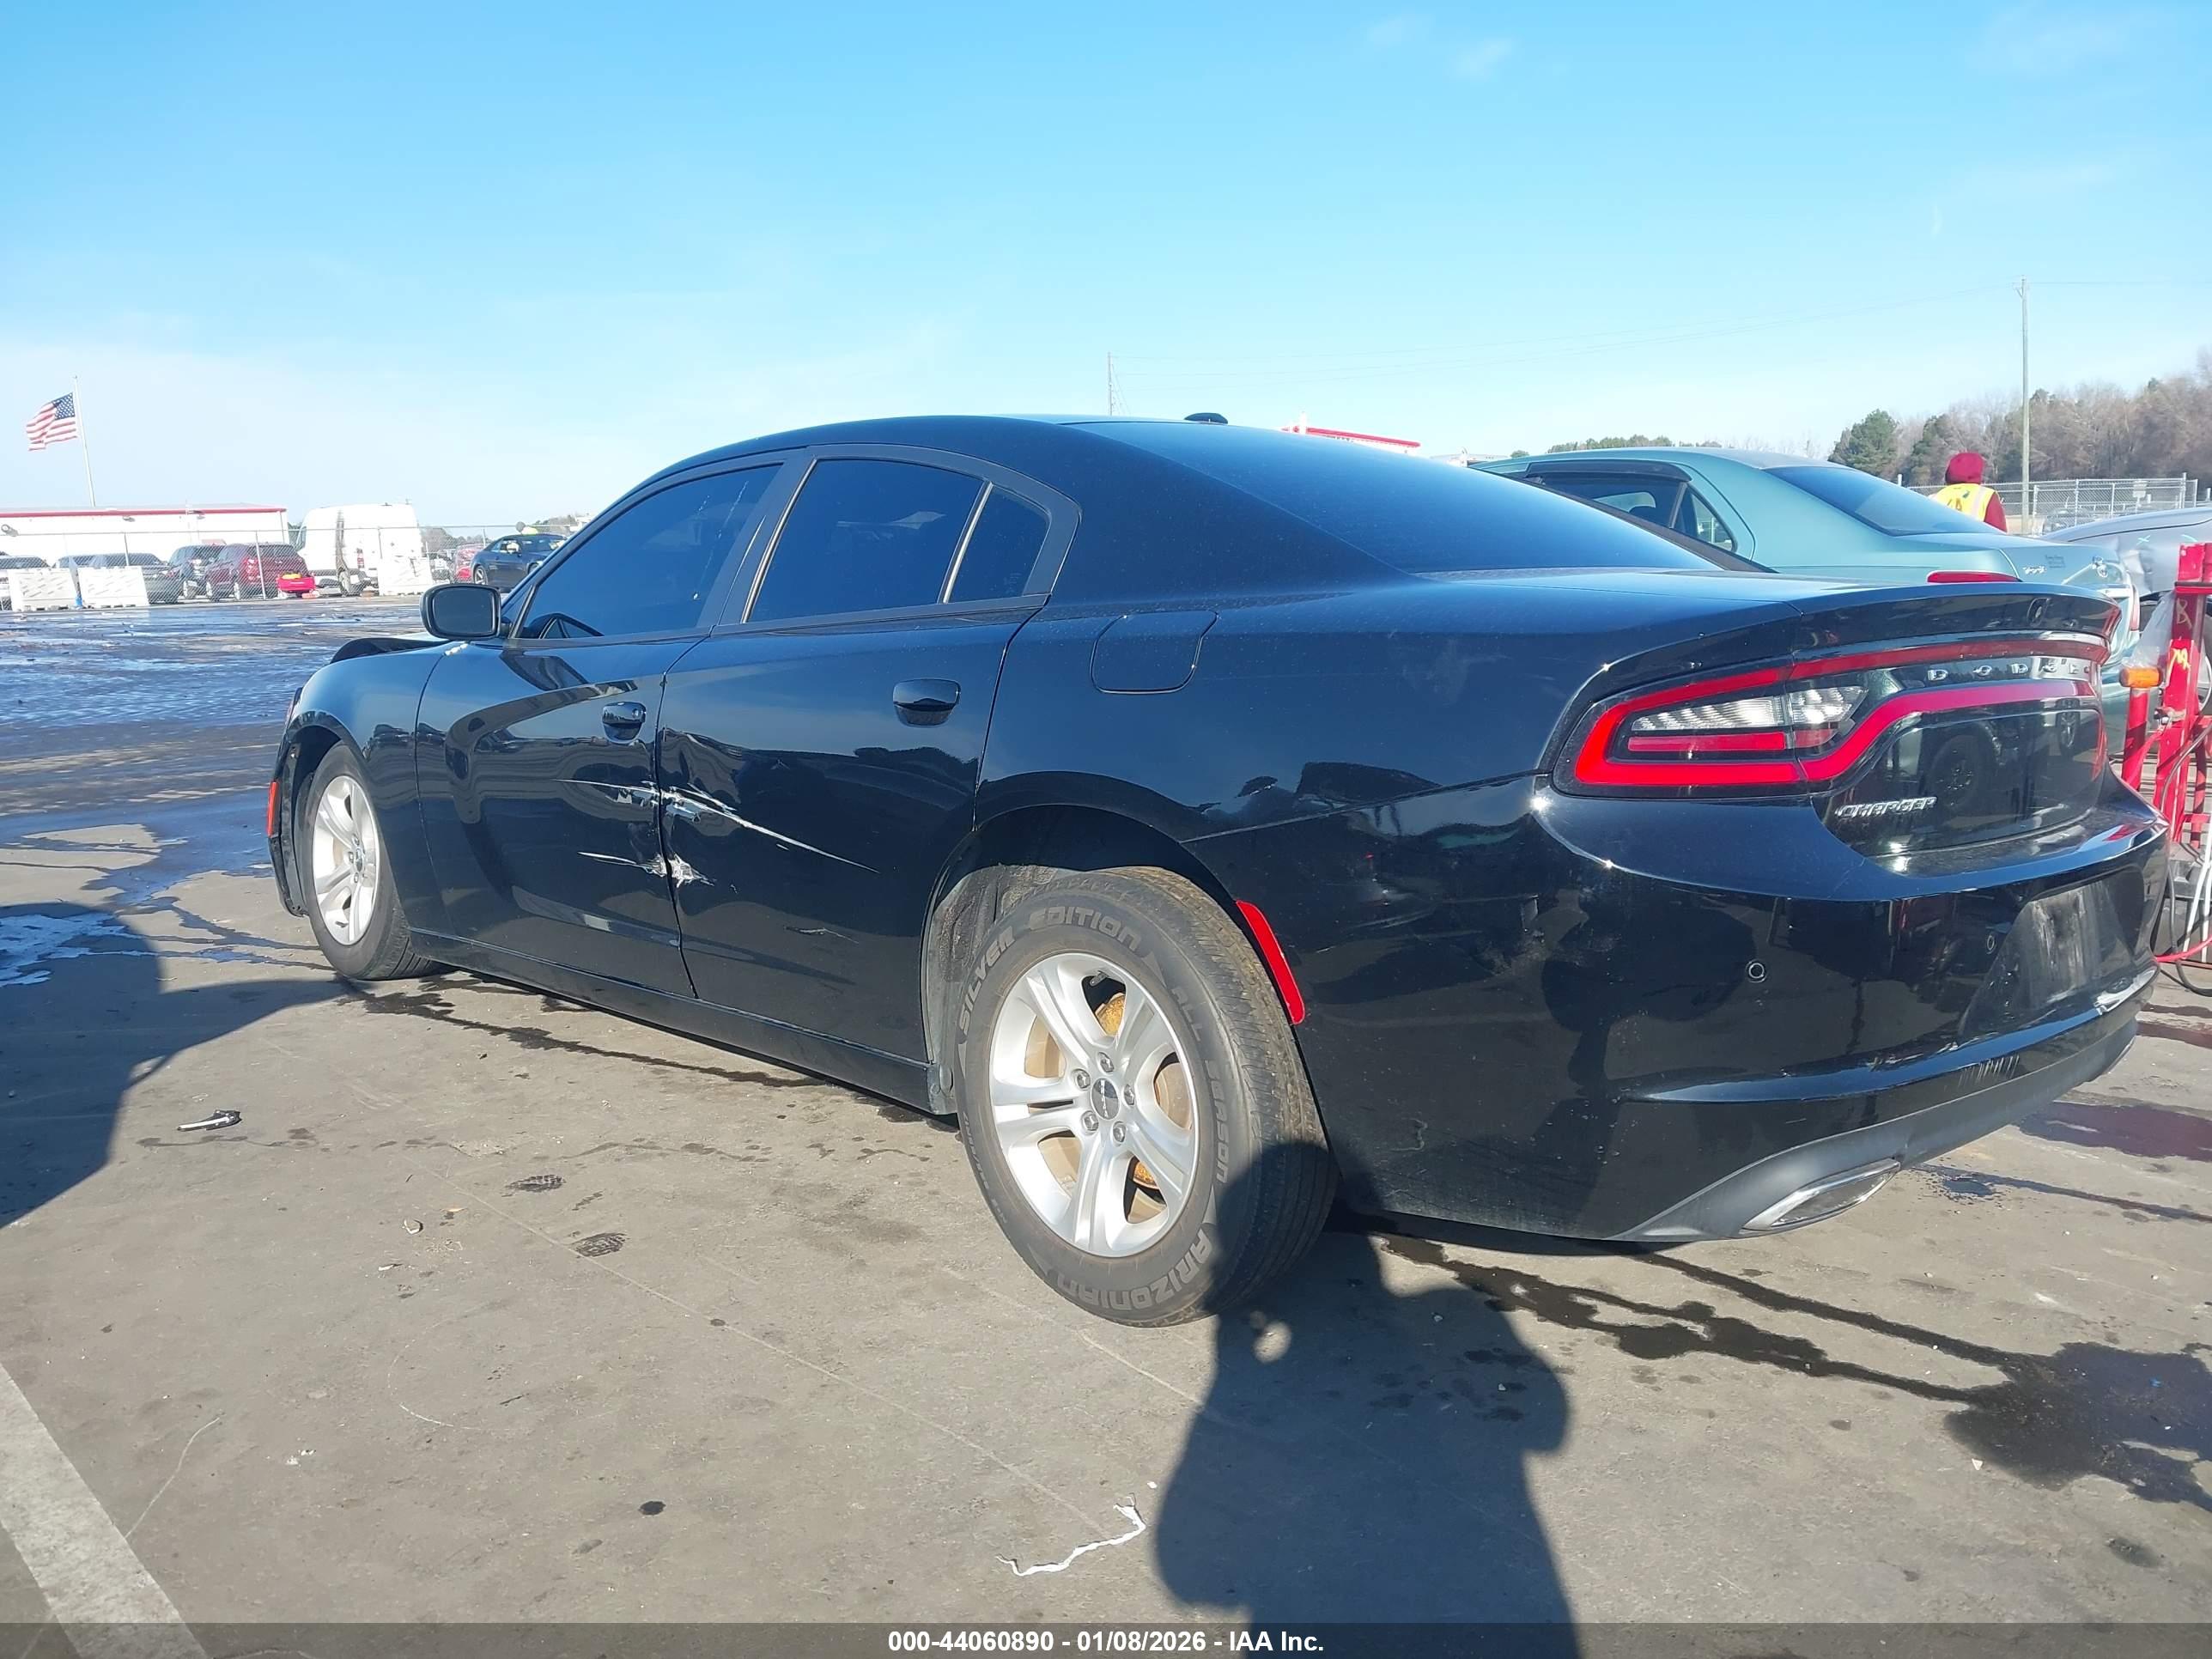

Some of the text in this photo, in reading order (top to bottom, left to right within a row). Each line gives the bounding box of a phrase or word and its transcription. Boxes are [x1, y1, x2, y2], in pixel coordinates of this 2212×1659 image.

[958, 906, 1142, 1035] SILVER EDITION
[1057, 1228, 1212, 1310] ARIZONIAN
